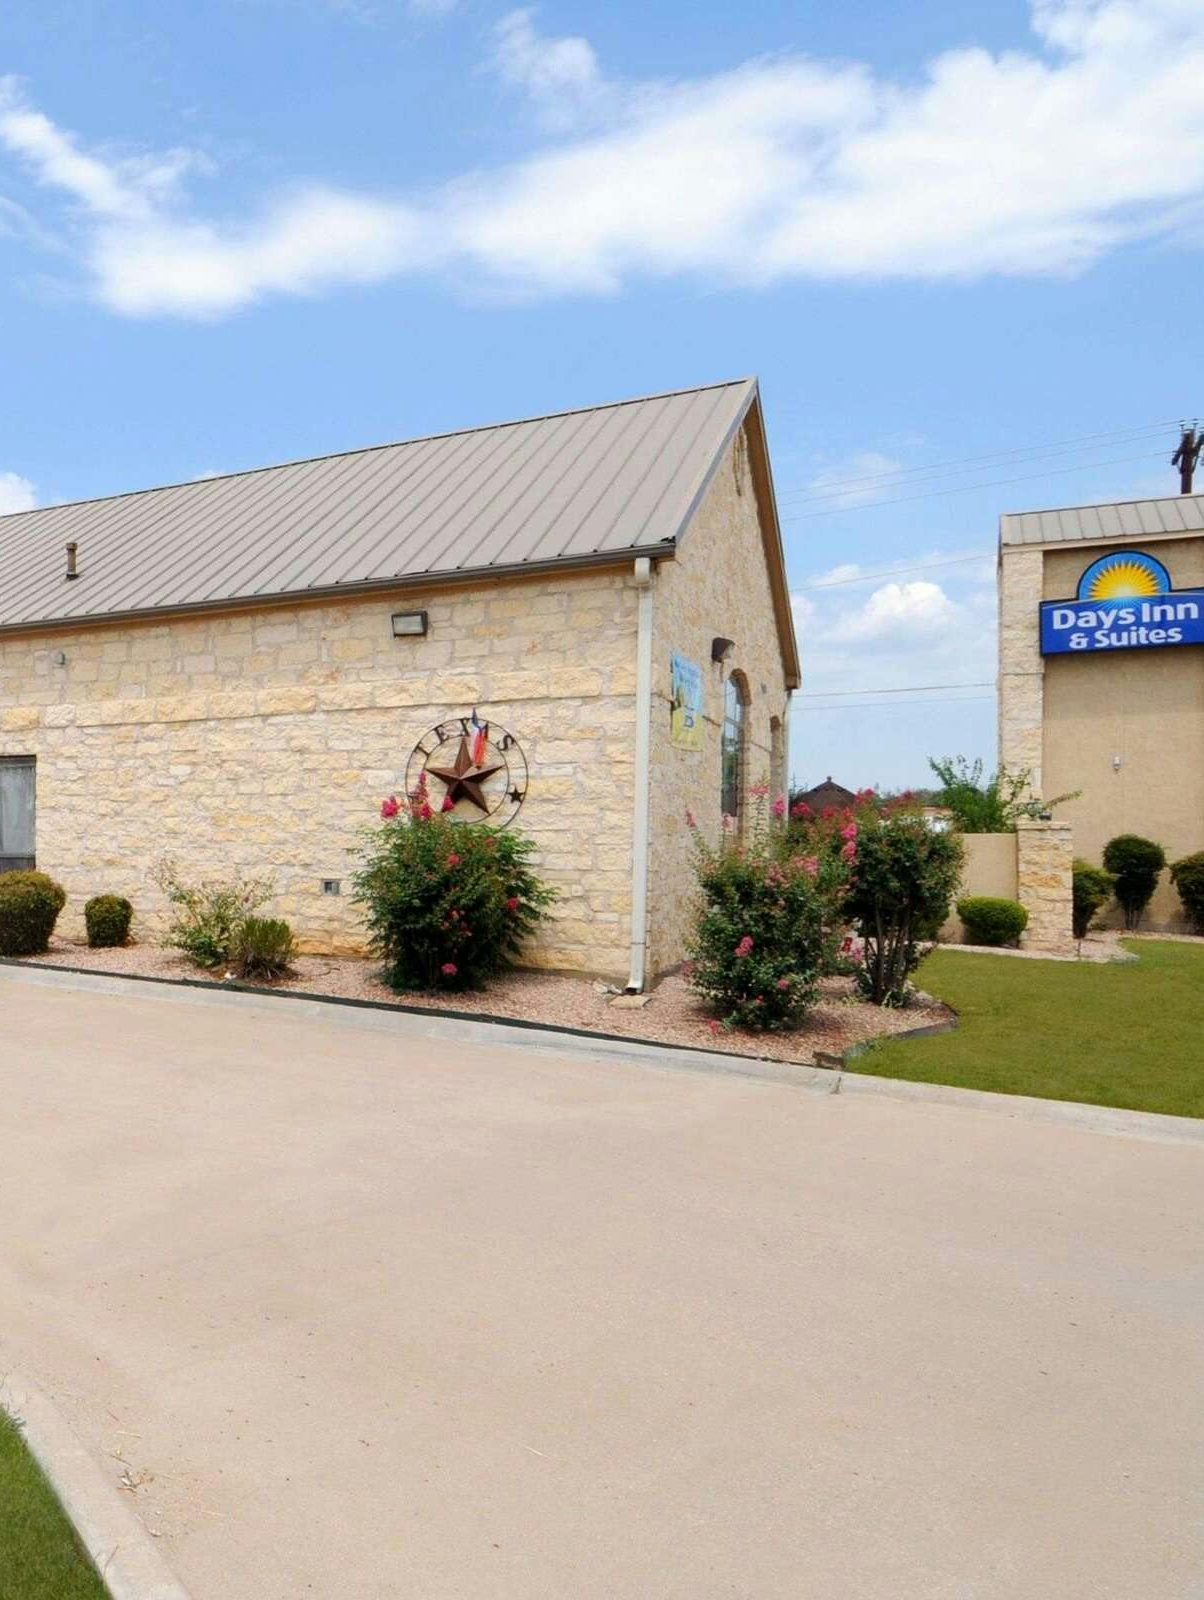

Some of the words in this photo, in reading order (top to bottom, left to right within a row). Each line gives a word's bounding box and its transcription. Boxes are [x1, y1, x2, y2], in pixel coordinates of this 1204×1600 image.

[1052, 608, 1136, 630] Days
[1141, 602, 1199, 622] Inn
[1069, 632, 1089, 649] &
[1094, 626, 1183, 648] Suites
